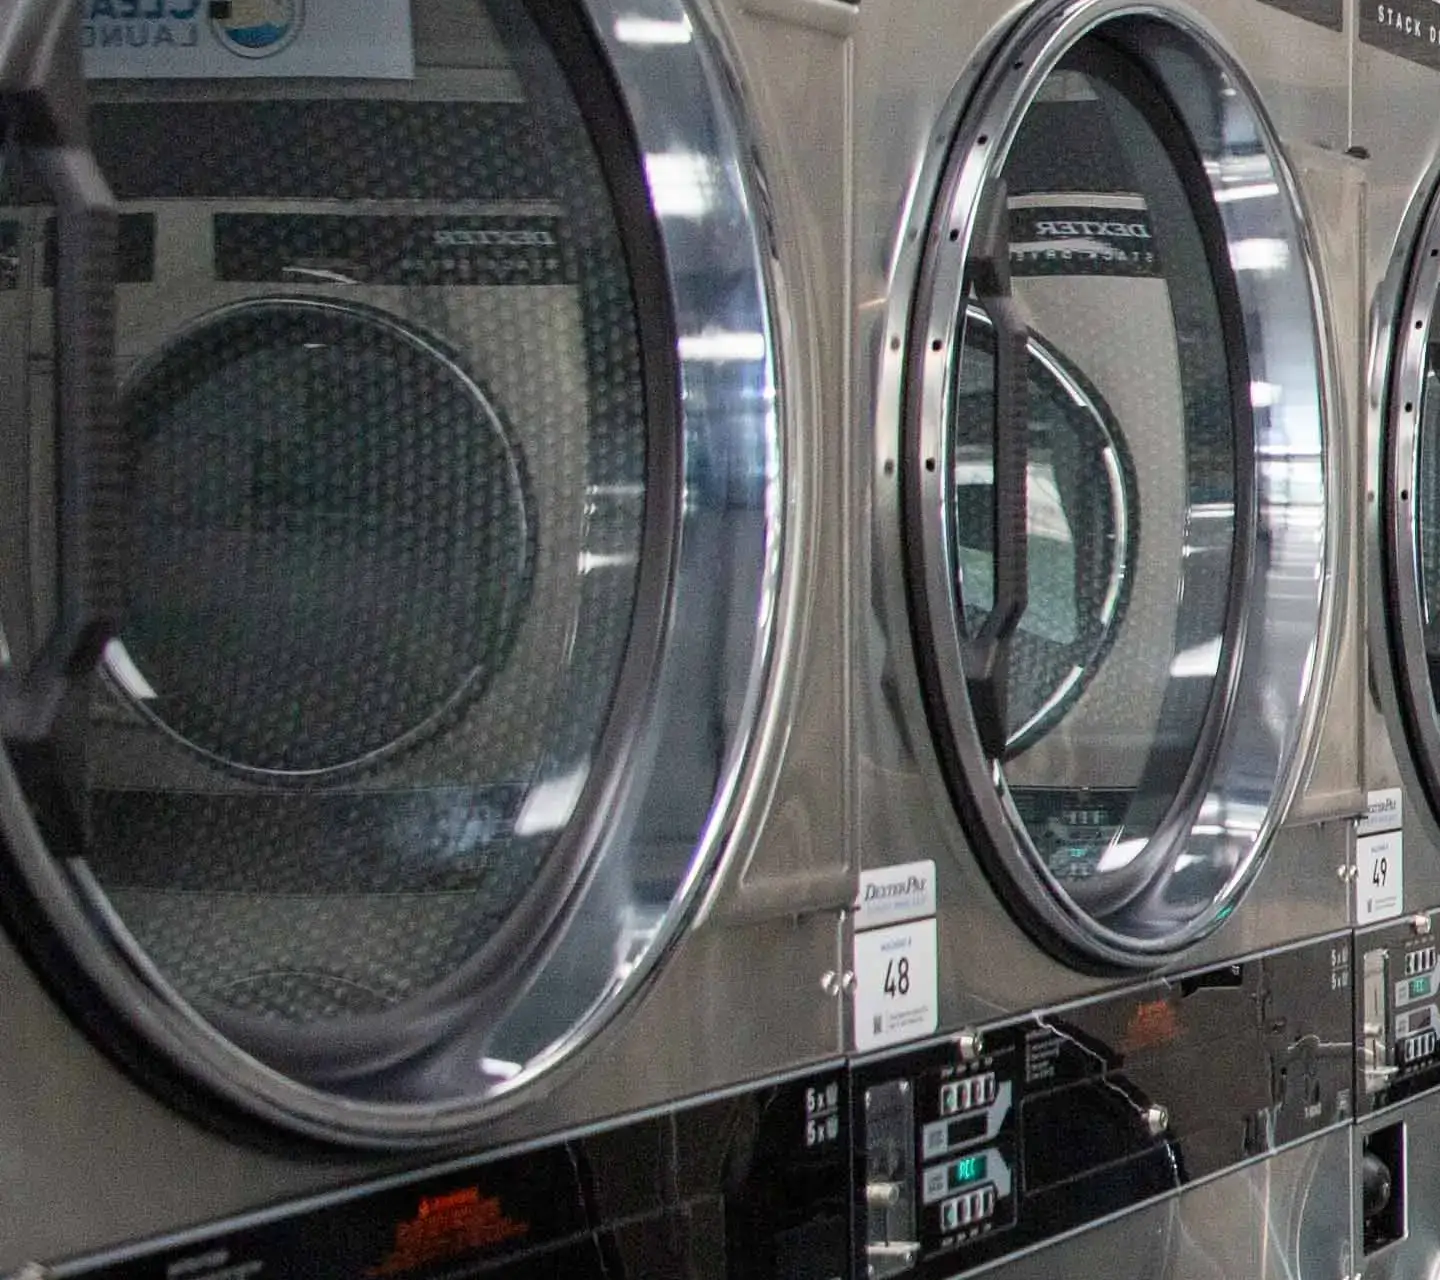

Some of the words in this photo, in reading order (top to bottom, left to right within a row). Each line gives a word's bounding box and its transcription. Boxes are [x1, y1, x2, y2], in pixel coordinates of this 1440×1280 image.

[1377, 4, 1421, 37] STACK
[1373, 857, 1387, 887] 49
[884, 958, 909, 998] 48
